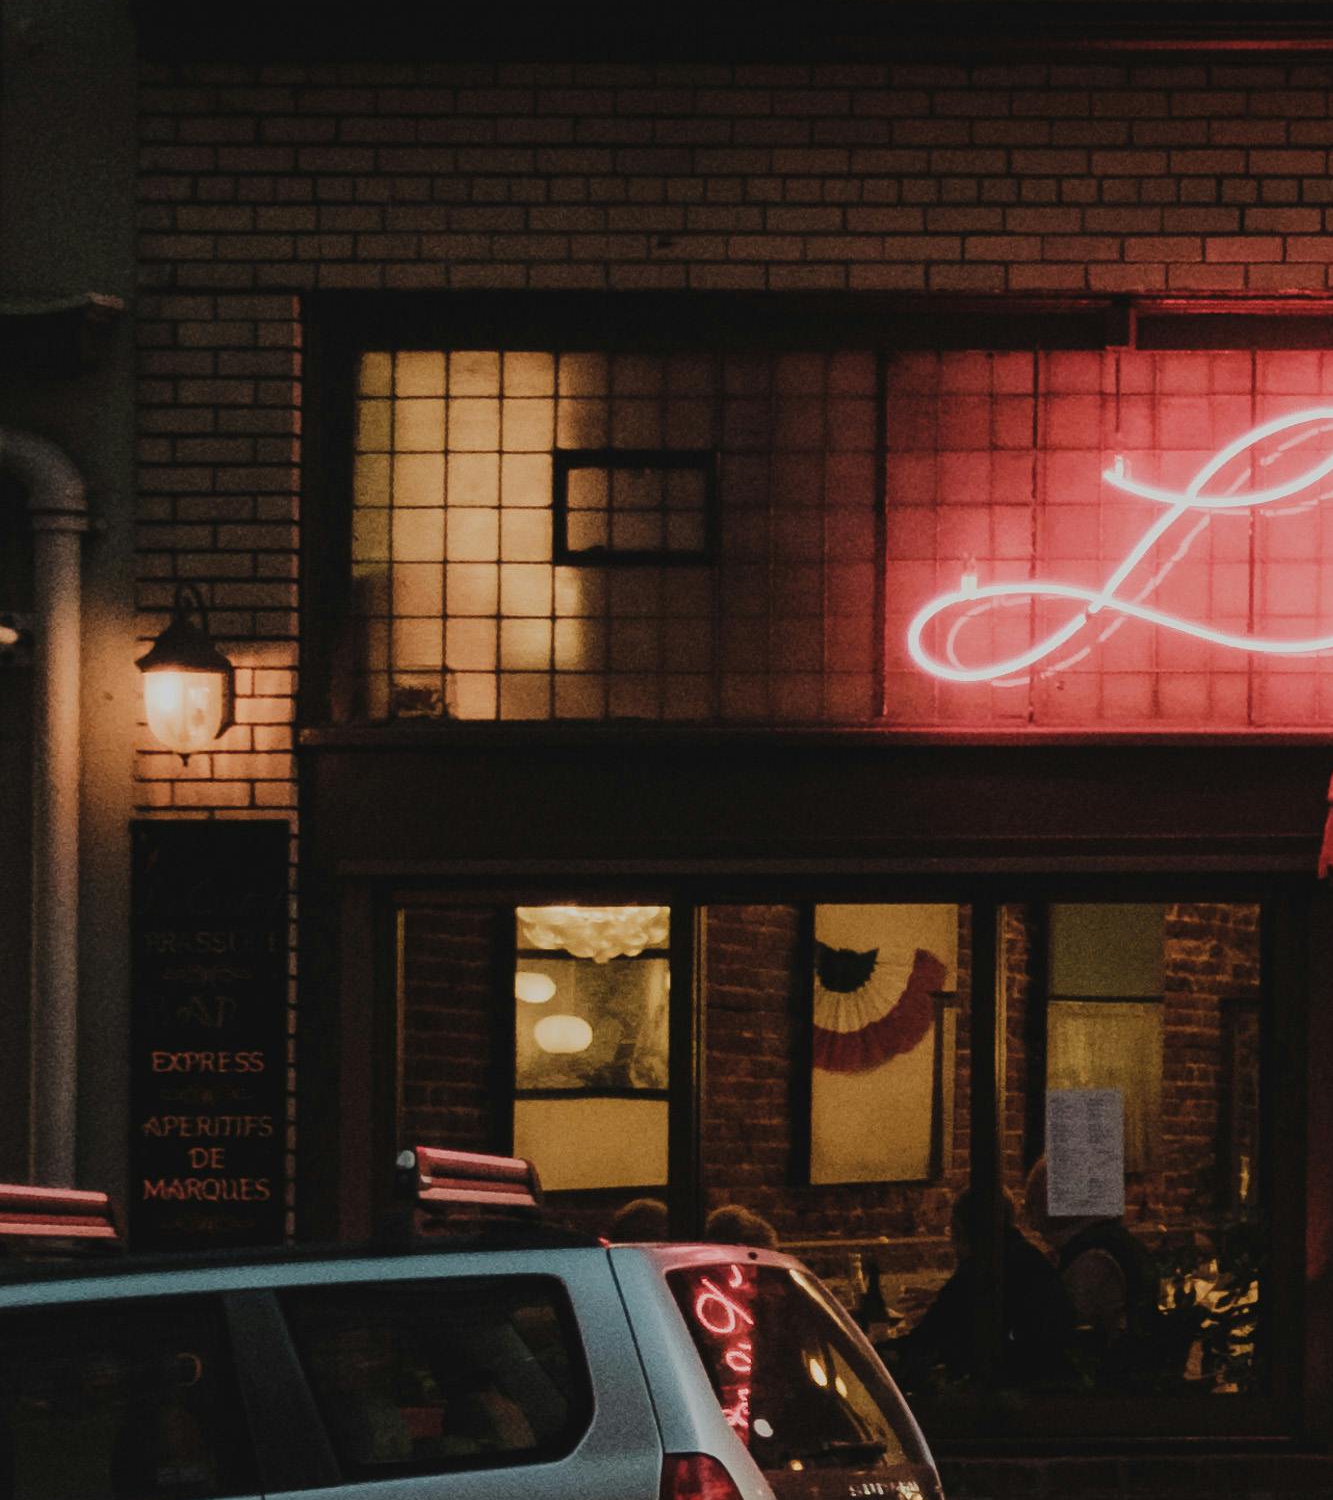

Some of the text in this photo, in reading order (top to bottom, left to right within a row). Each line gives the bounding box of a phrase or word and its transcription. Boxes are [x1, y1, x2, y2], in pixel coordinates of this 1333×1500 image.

[152, 1050, 265, 1073] EXPRESS
[142, 1115, 274, 1138] APERITIFS
[187, 1147, 226, 1170] DE
[142, 1177, 272, 1203] MARQUES
